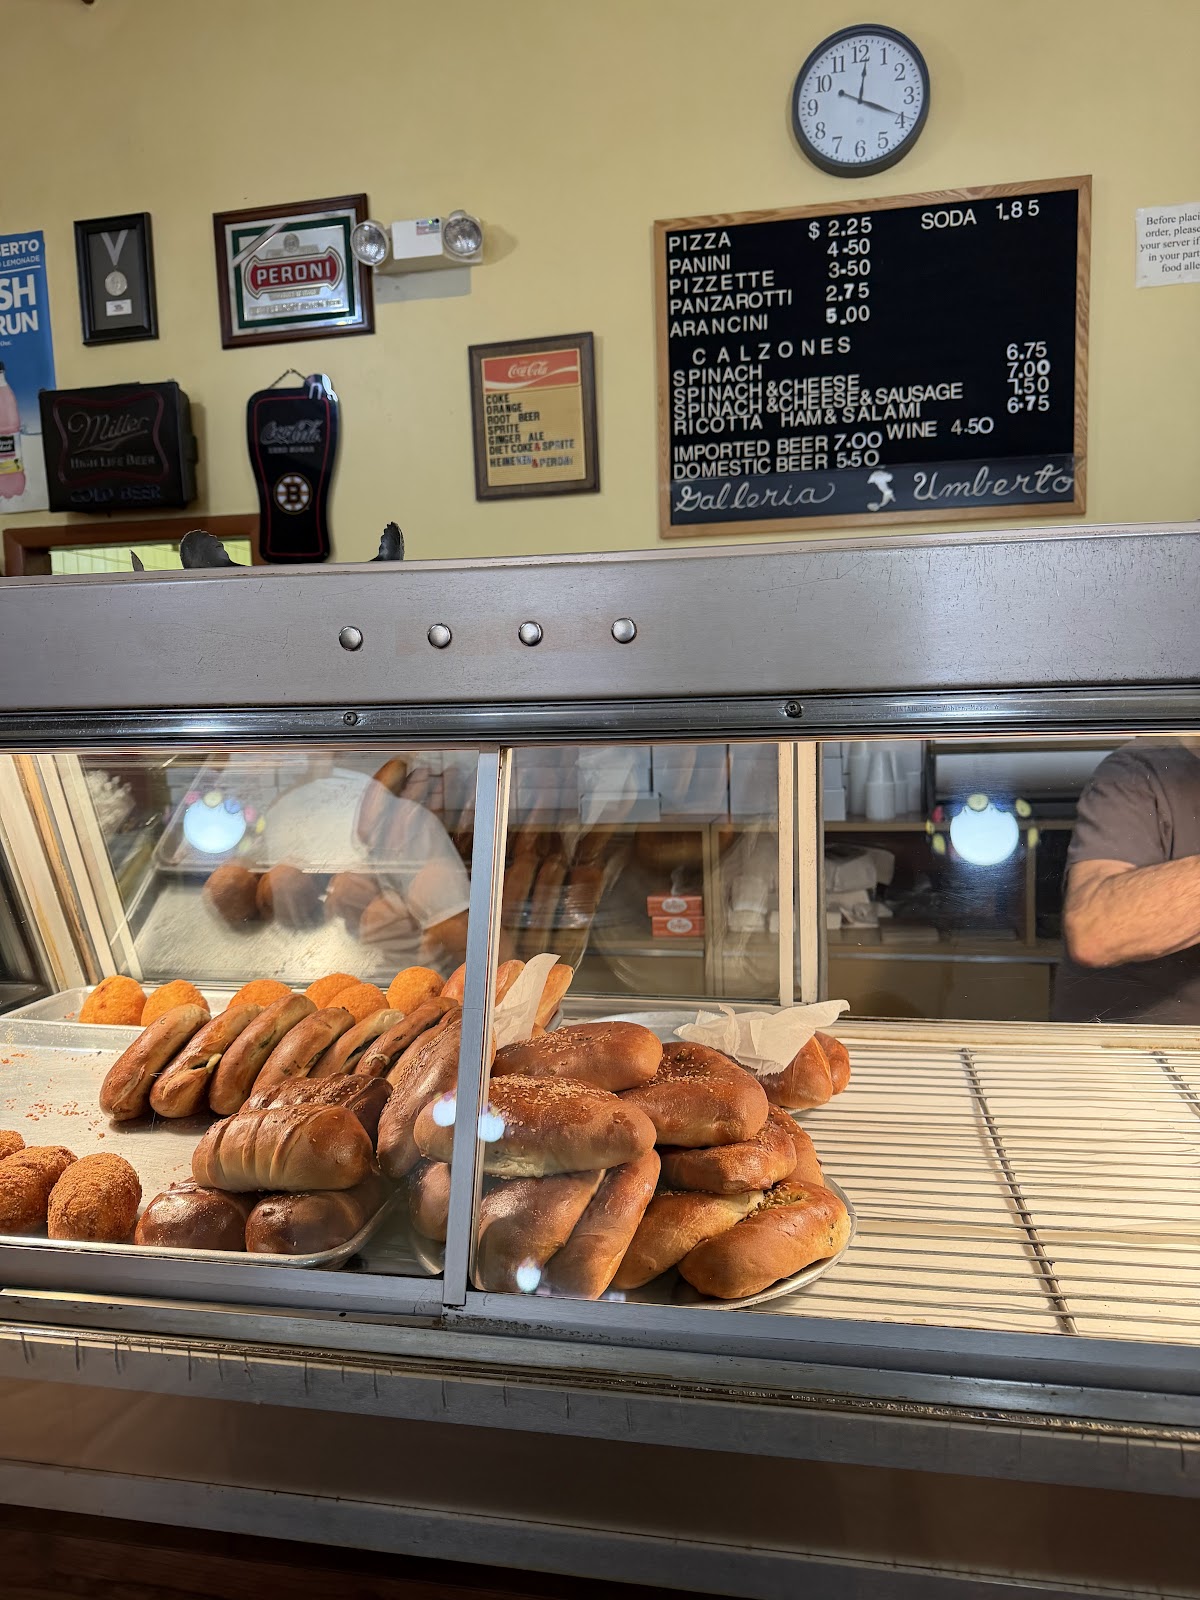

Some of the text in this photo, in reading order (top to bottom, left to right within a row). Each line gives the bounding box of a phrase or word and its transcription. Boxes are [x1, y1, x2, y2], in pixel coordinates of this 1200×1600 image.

[851, 44, 869, 64] 12
[880, 47, 888, 66] 1
[831, 55, 846, 74] 11
[894, 63, 906, 81] 2
[815, 74, 832, 93] 10
[903, 86, 915, 104] 3
[807, 99, 819, 116] 9
[894, 111, 906, 129] 4
[815, 121, 826, 139] 8
[832, 136, 843, 154] 7
[854, 140, 866, 158] 6
[877, 131, 889, 149] 5
[921, 200, 1039, 229] SODA 1.85
[1146, 215, 1176, 224] Before
[669, 231, 731, 252] PIZZA
[827, 216, 872, 236] 2.25
[1145, 229, 1170, 237] order,
[0, 239, 40, 257] ERTO
[1140, 242, 1159, 252] your
[1162, 239, 1189, 247] server
[2, 254, 40, 267] LEMONADE
[669, 253, 730, 275] PANINI
[1148, 253, 1156, 261] in
[1159, 252, 1179, 262] your
[255, 261, 330, 285] PERONI
[1161, 263, 1181, 272] food
[669, 270, 774, 295] PIZZETTE
[670, 282, 869, 315] PANZAROTTI 2.75
[669, 304, 870, 338] ARANCINI 5.00
[673, 341, 1047, 387] SPINACH 6.75
[673, 381, 762, 404] SPINACH
[1006, 359, 1050, 378] 7.00
[486, 393, 509, 404] COKE
[673, 399, 762, 420] SPINACH
[875, 382, 963, 405] SAUSAGE
[486, 403, 522, 414] ORANGE
[487, 411, 539, 424] ROOT BEER
[674, 413, 762, 435] RICOTTA
[841, 402, 920, 423] SALAMI
[886, 416, 993, 439] WINE 4.50
[68, 412, 149, 446] Miller
[487, 423, 519, 434] SPRITE
[488, 431, 544, 444] GINGER ALE
[489, 444, 509, 455] DIET
[511, 442, 532, 453] COKE
[542, 439, 574, 451] SPRITE
[674, 439, 769, 462] IMPORTED
[777, 434, 828, 454] BEER
[70, 454, 155, 467] HIGH LIFE BEER
[673, 457, 770, 479] DOMESTIC
[776, 453, 827, 471] BEER
[674, 464, 1074, 511] Galleria Umberto
